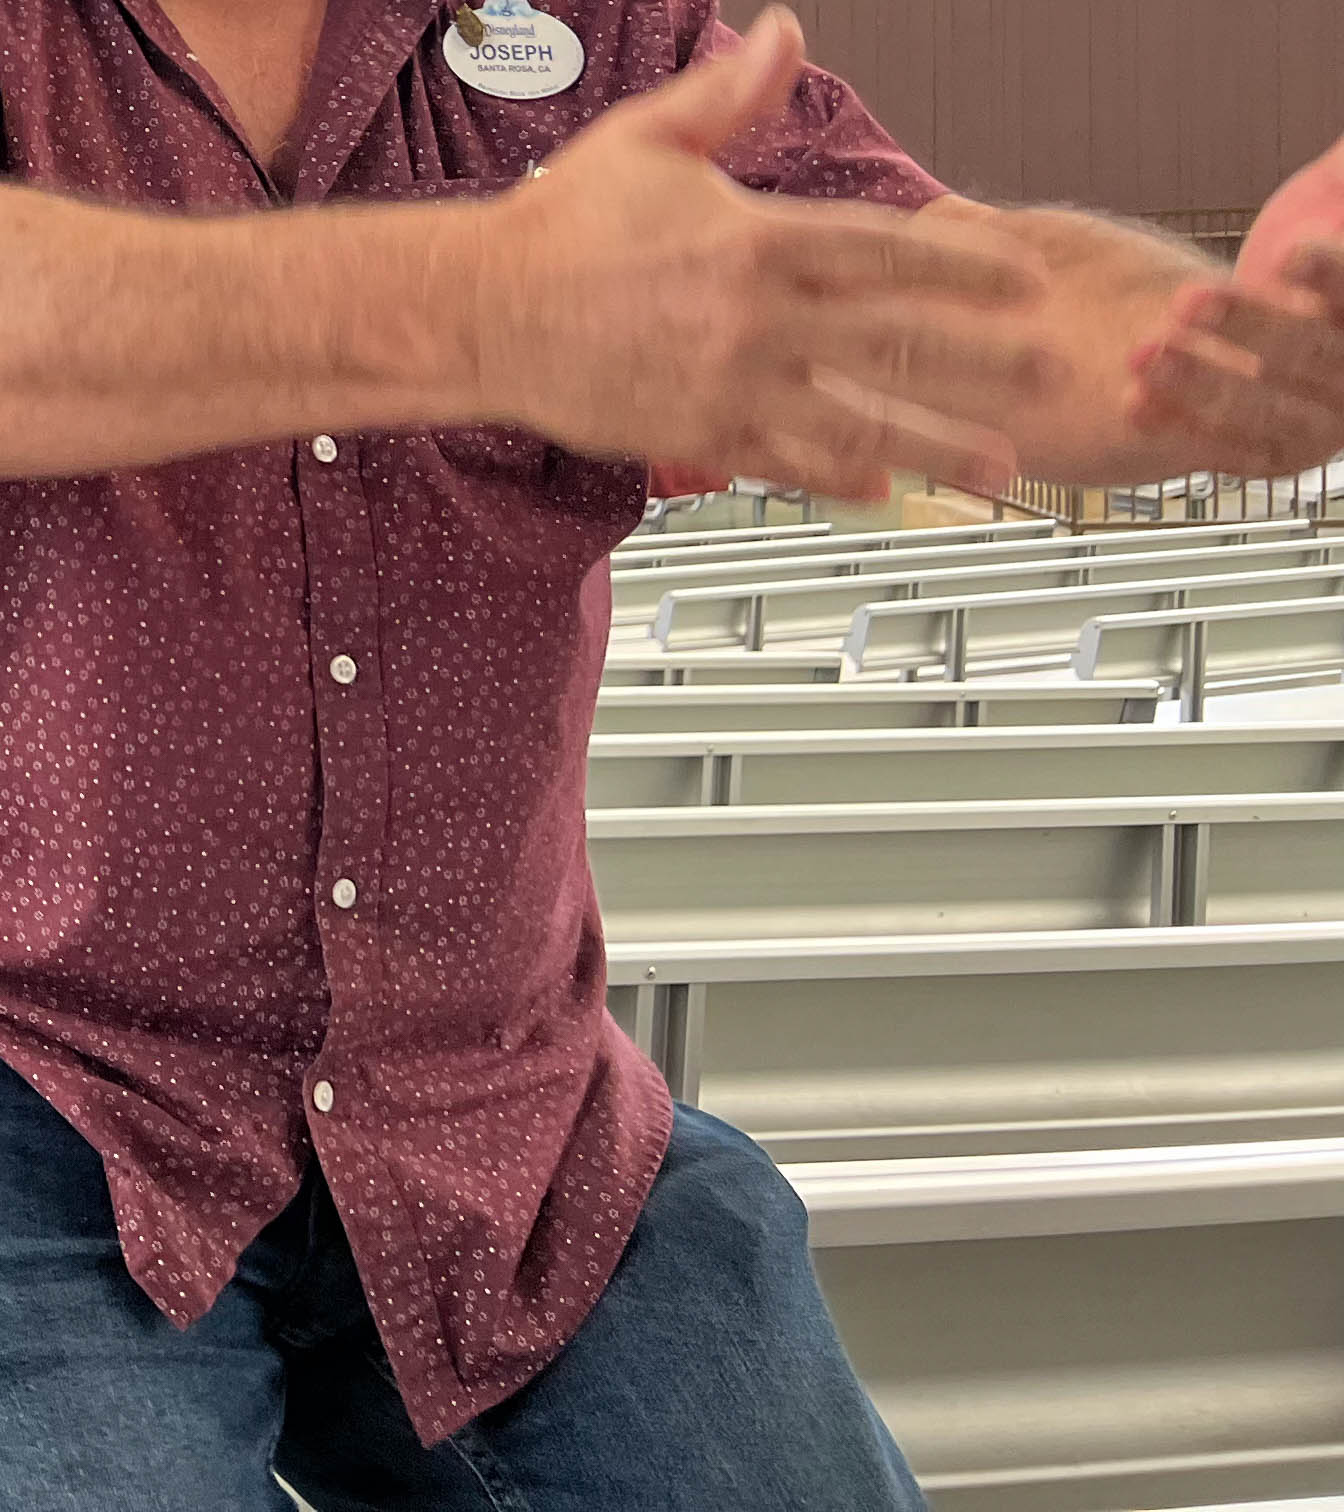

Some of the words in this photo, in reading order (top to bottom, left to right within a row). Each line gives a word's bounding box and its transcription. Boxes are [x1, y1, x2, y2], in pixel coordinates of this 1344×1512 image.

[470, 44, 553, 61] JOSEPH
[477, 64, 507, 73] SANTA
[509, 64, 536, 74] ROSA,
[538, 64, 552, 73] CA
